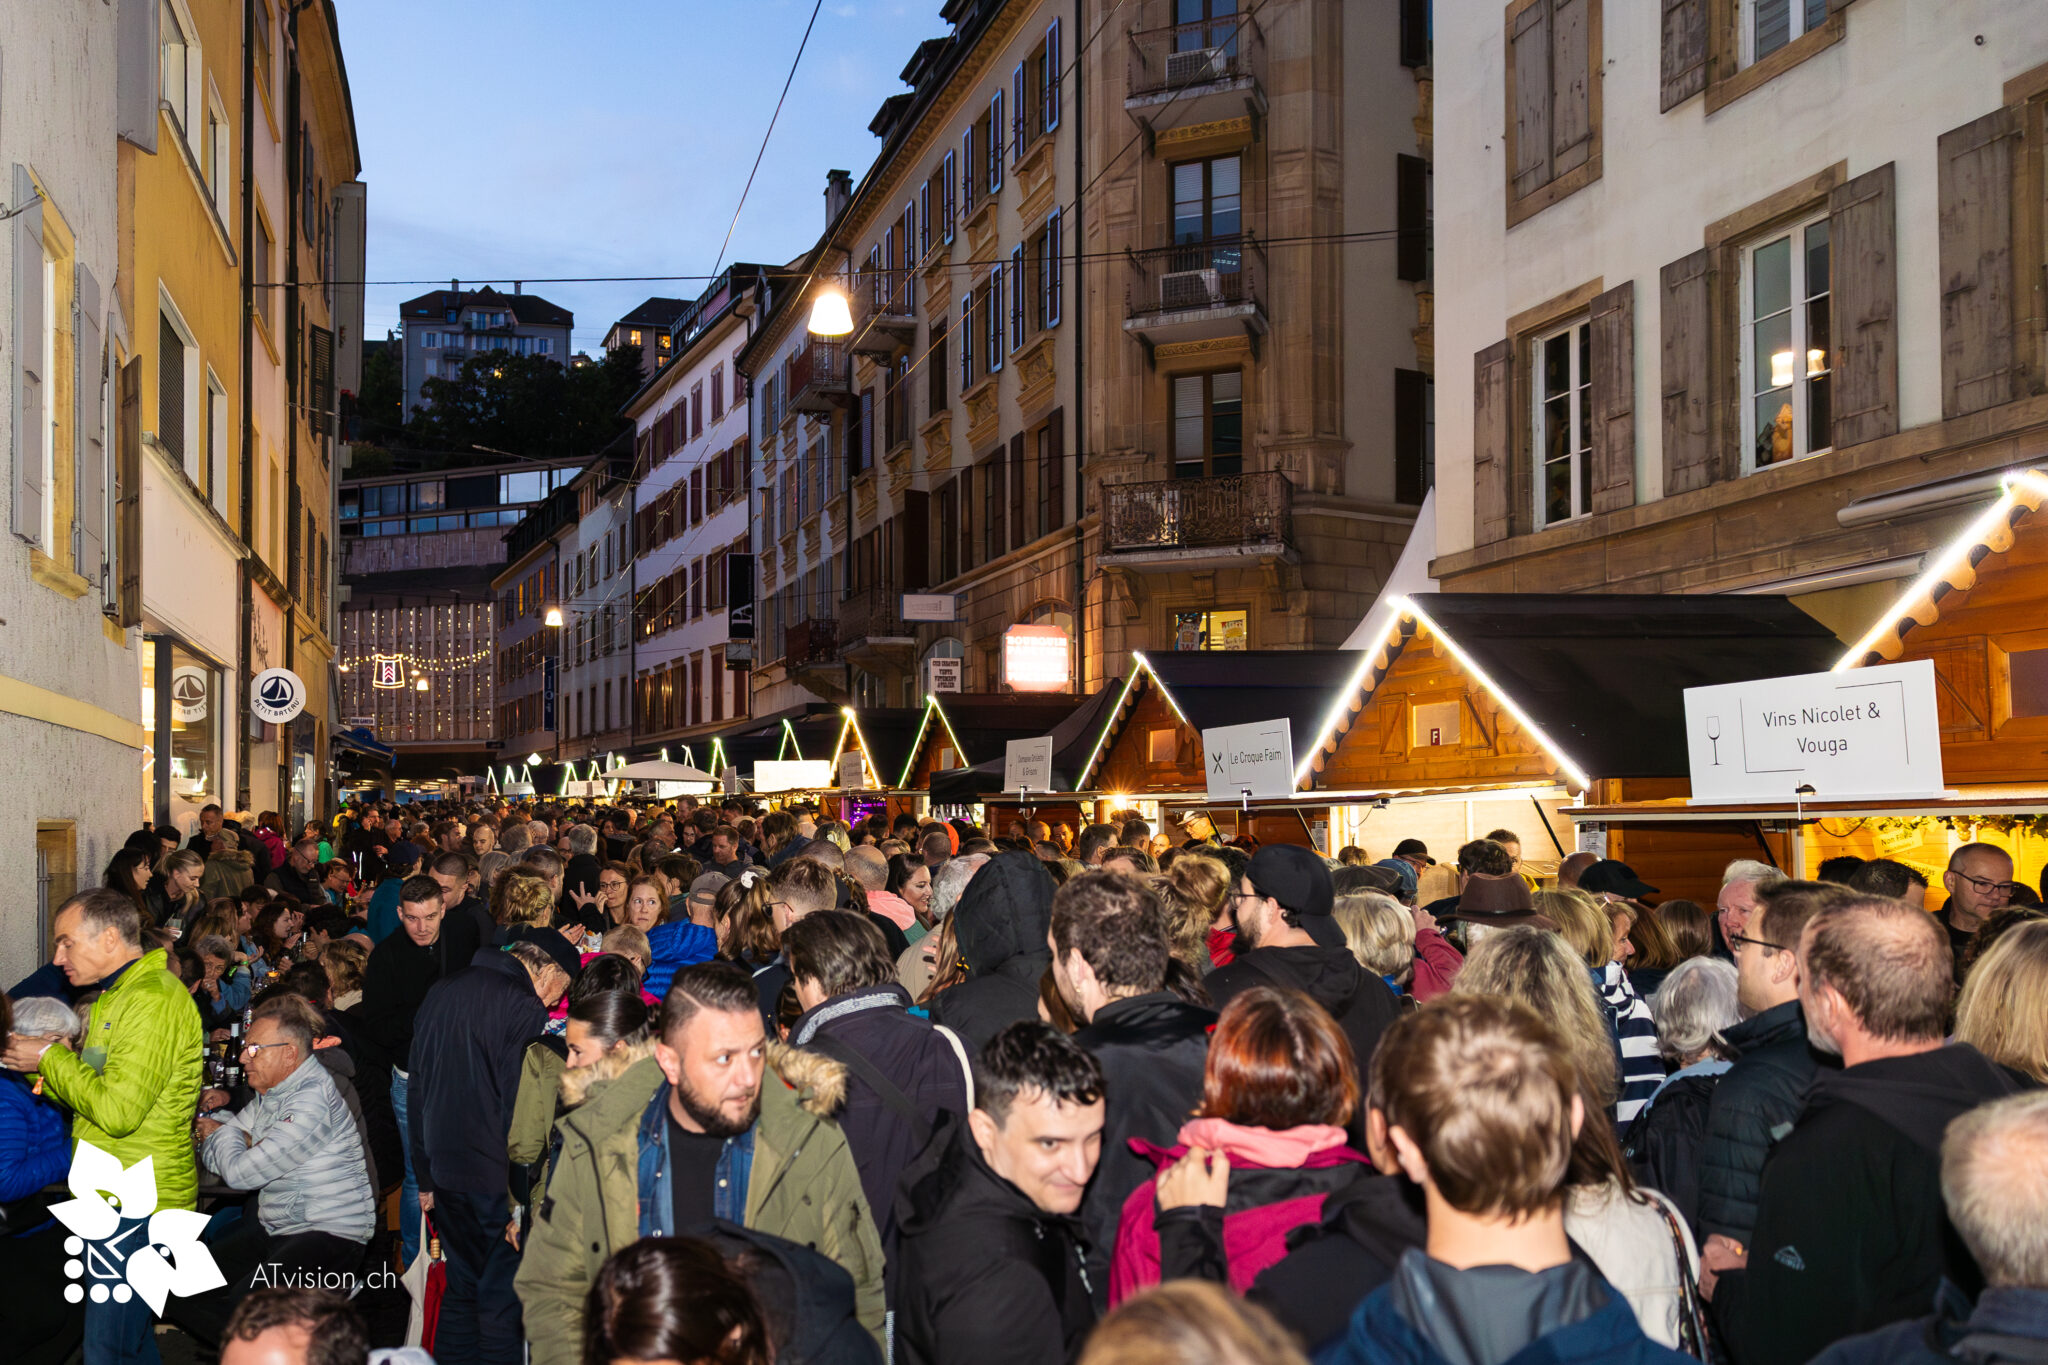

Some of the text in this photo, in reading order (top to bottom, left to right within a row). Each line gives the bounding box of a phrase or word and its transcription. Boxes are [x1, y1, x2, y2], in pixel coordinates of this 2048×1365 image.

[253, 698, 300, 717] PETIT BATEAU
[1762, 702, 1881, 727] Vins Nicolet &
[1432, 730, 1438, 744] F
[1796, 737, 1849, 756] Vouga
[1230, 748, 1282, 766] Le Croque Faim
